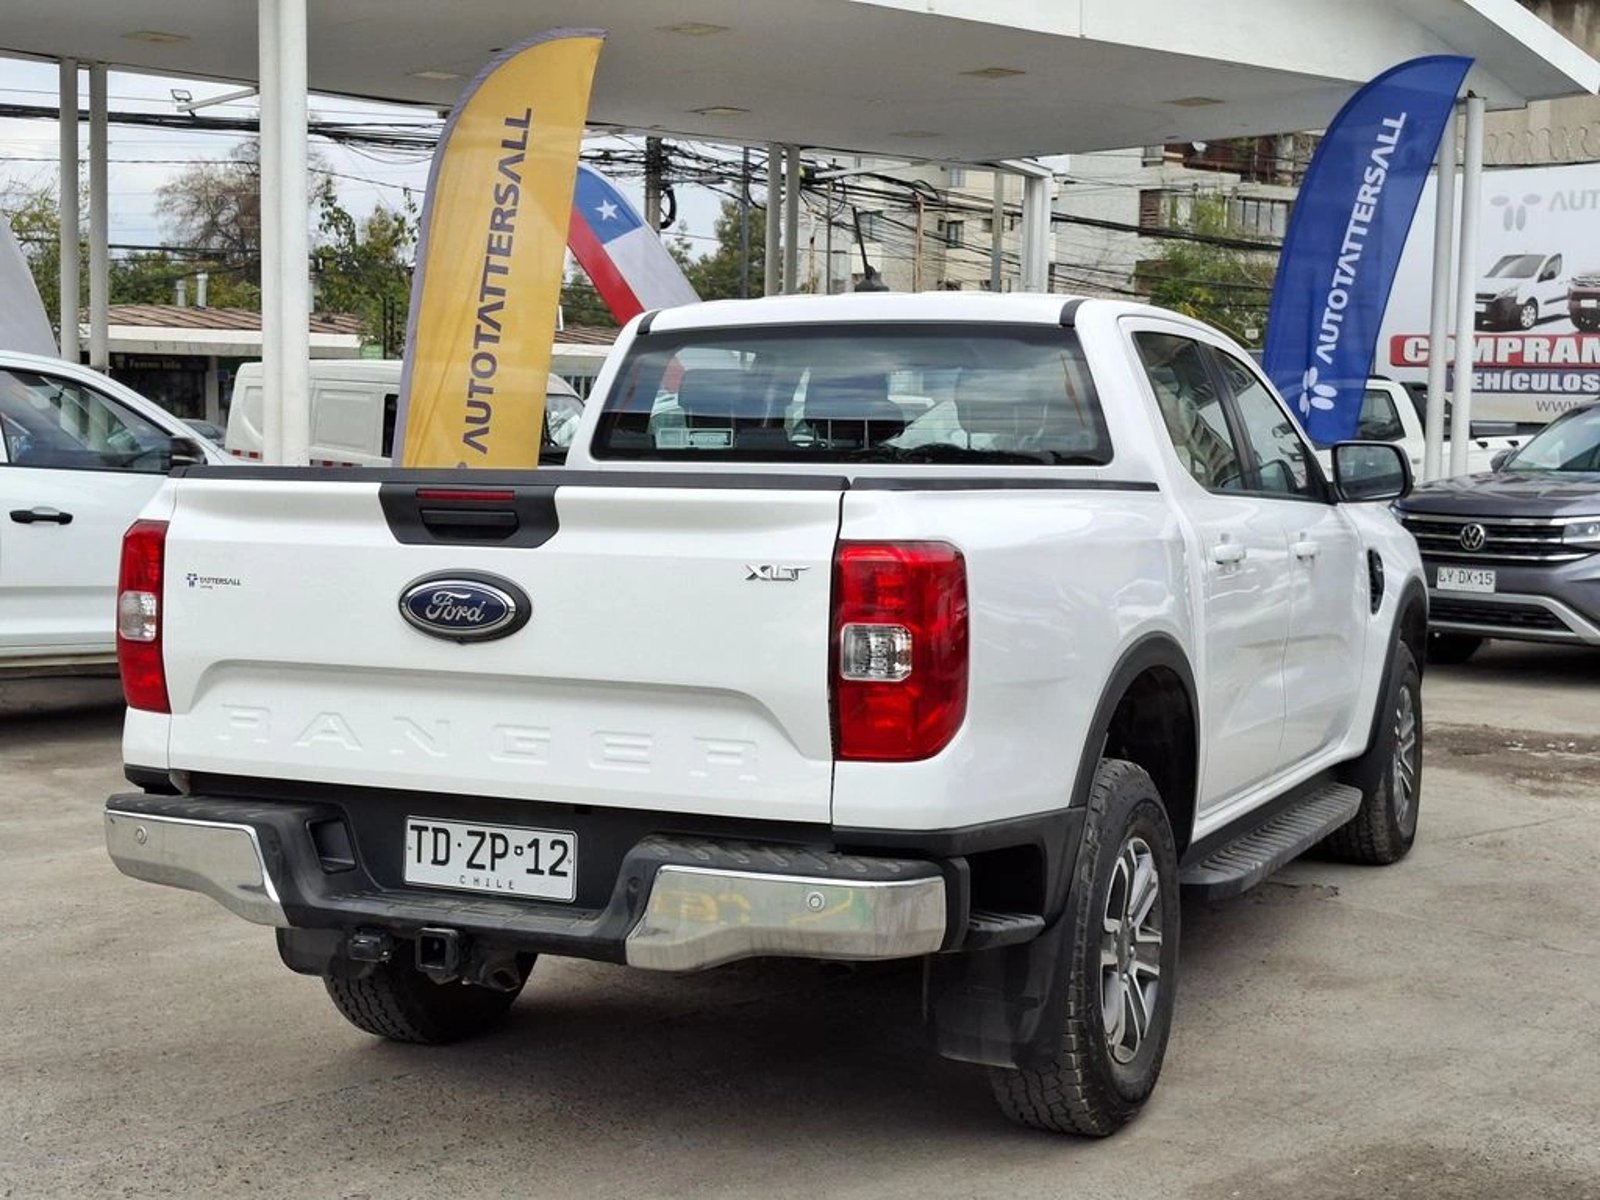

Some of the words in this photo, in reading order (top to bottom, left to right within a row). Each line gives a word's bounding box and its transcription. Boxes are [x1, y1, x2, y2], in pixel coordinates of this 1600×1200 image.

[1316, 111, 1407, 365] AUTOTATTERSALL
[462, 107, 532, 454] AUTOTATTERSALL
[745, 564, 811, 581] XLT
[425, 590, 486, 622] Ford
[216, 703, 759, 782] RANGER
[459, 874, 515, 890] CHILE
